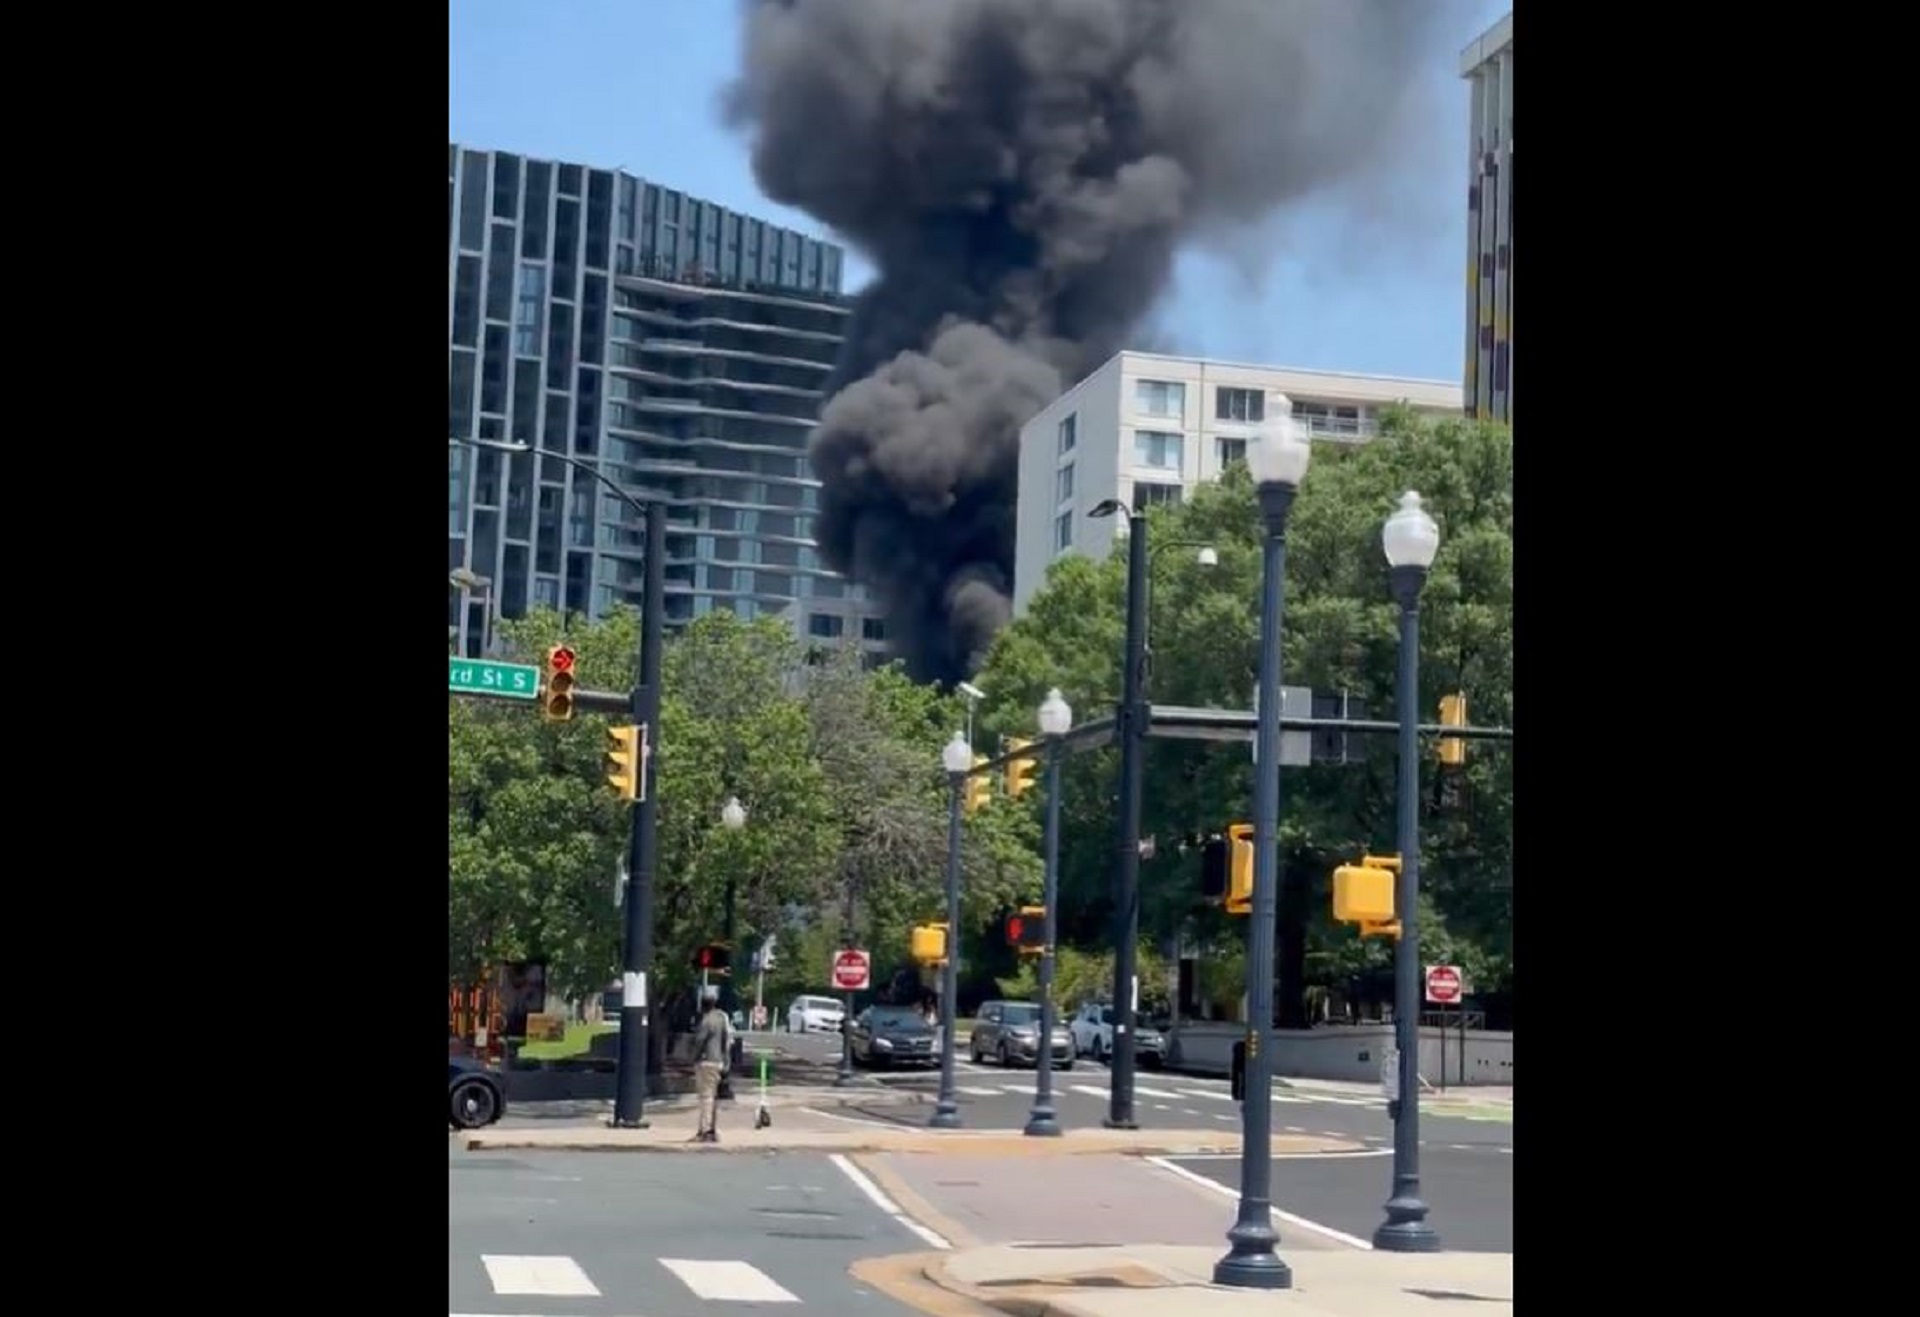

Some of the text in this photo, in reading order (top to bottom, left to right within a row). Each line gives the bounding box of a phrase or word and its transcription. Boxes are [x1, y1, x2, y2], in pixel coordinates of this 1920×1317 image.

[451, 666, 525, 689] rd St S
